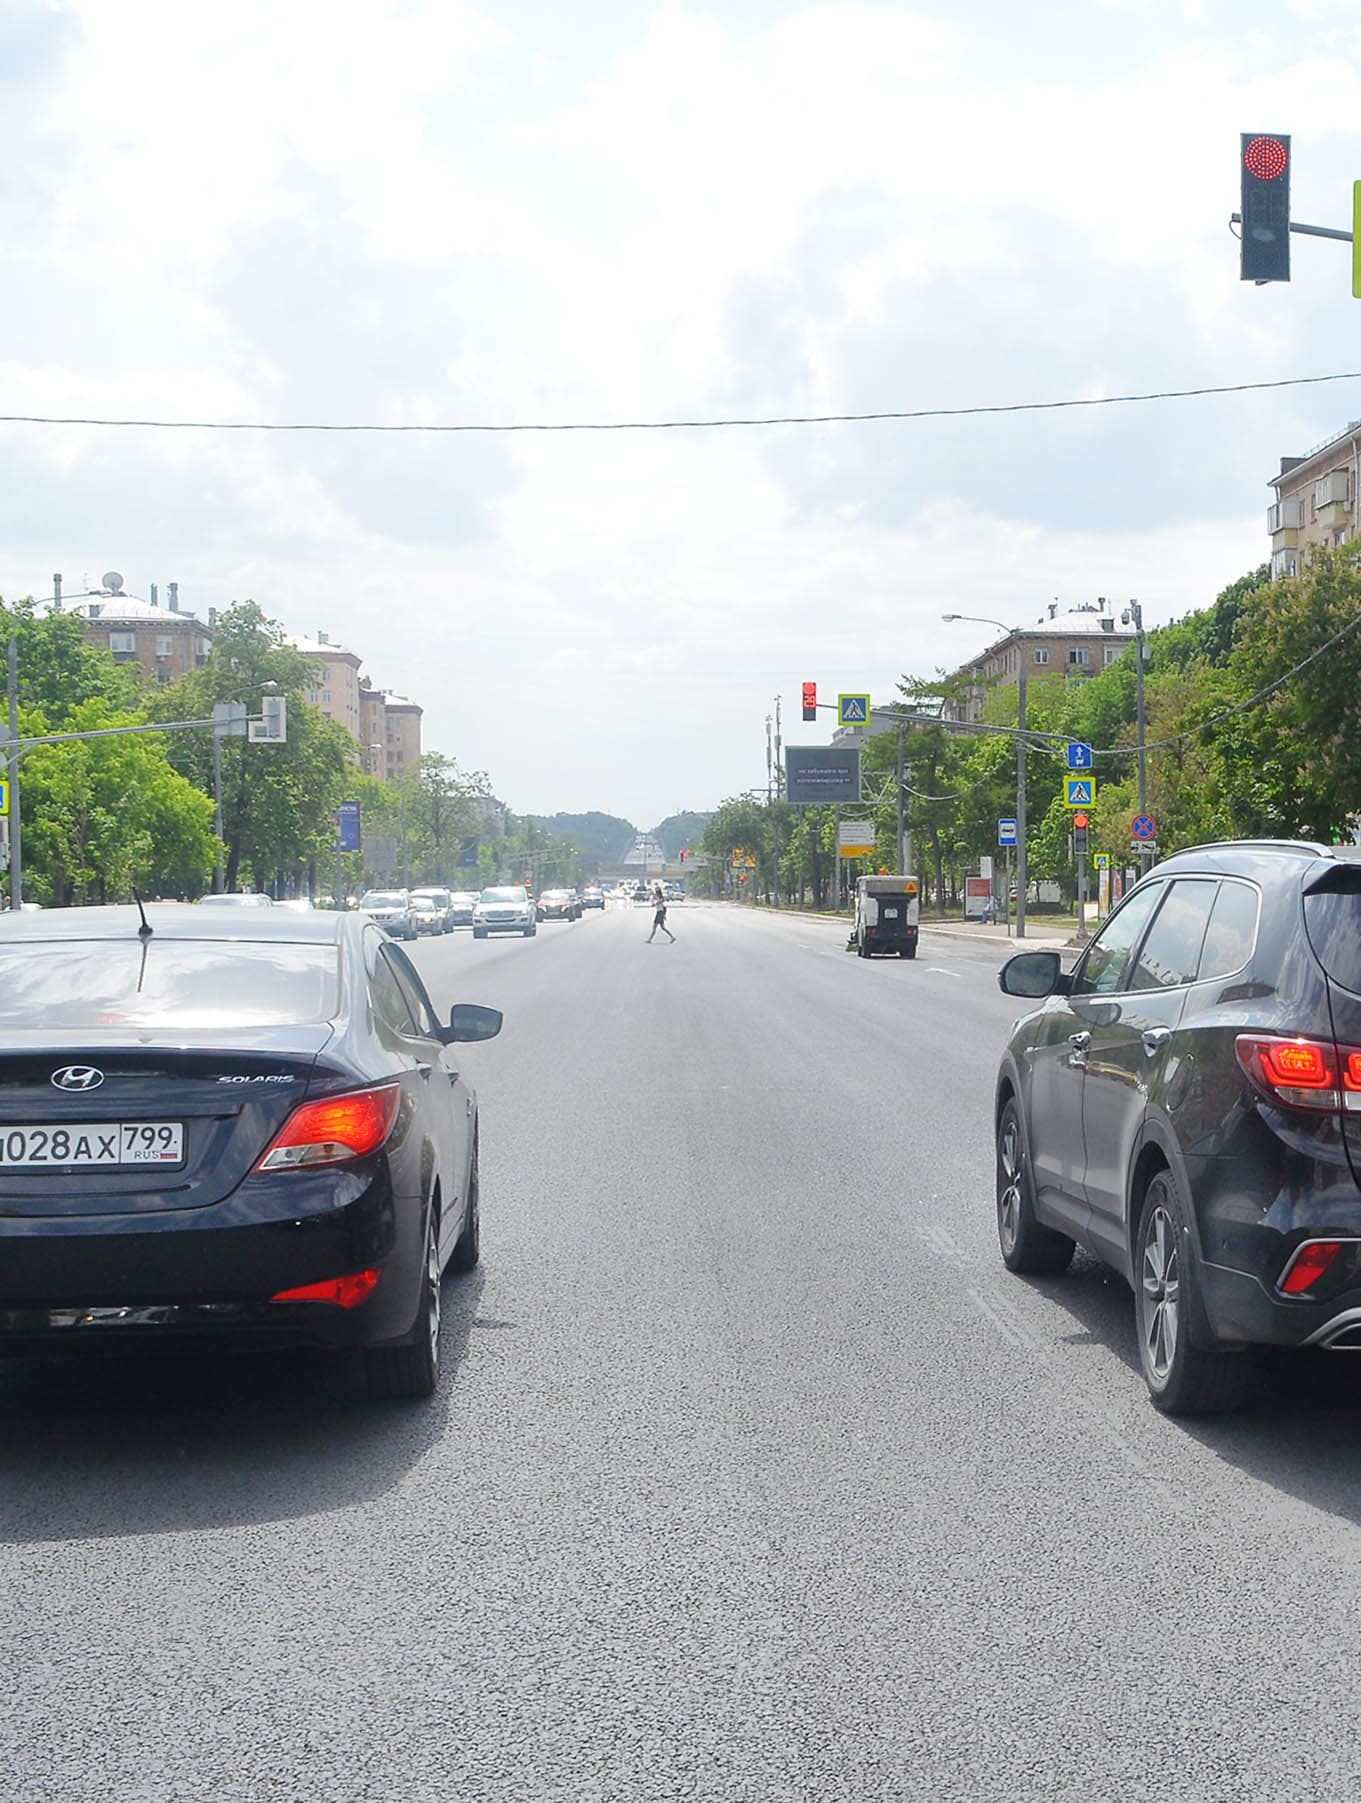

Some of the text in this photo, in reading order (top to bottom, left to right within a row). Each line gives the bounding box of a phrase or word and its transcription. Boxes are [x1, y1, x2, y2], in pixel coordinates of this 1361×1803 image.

[216, 1074, 295, 1084] SOLARIS
[0, 1126, 173, 1162] 028АХ 799
[135, 1151, 160, 1160] RUS
